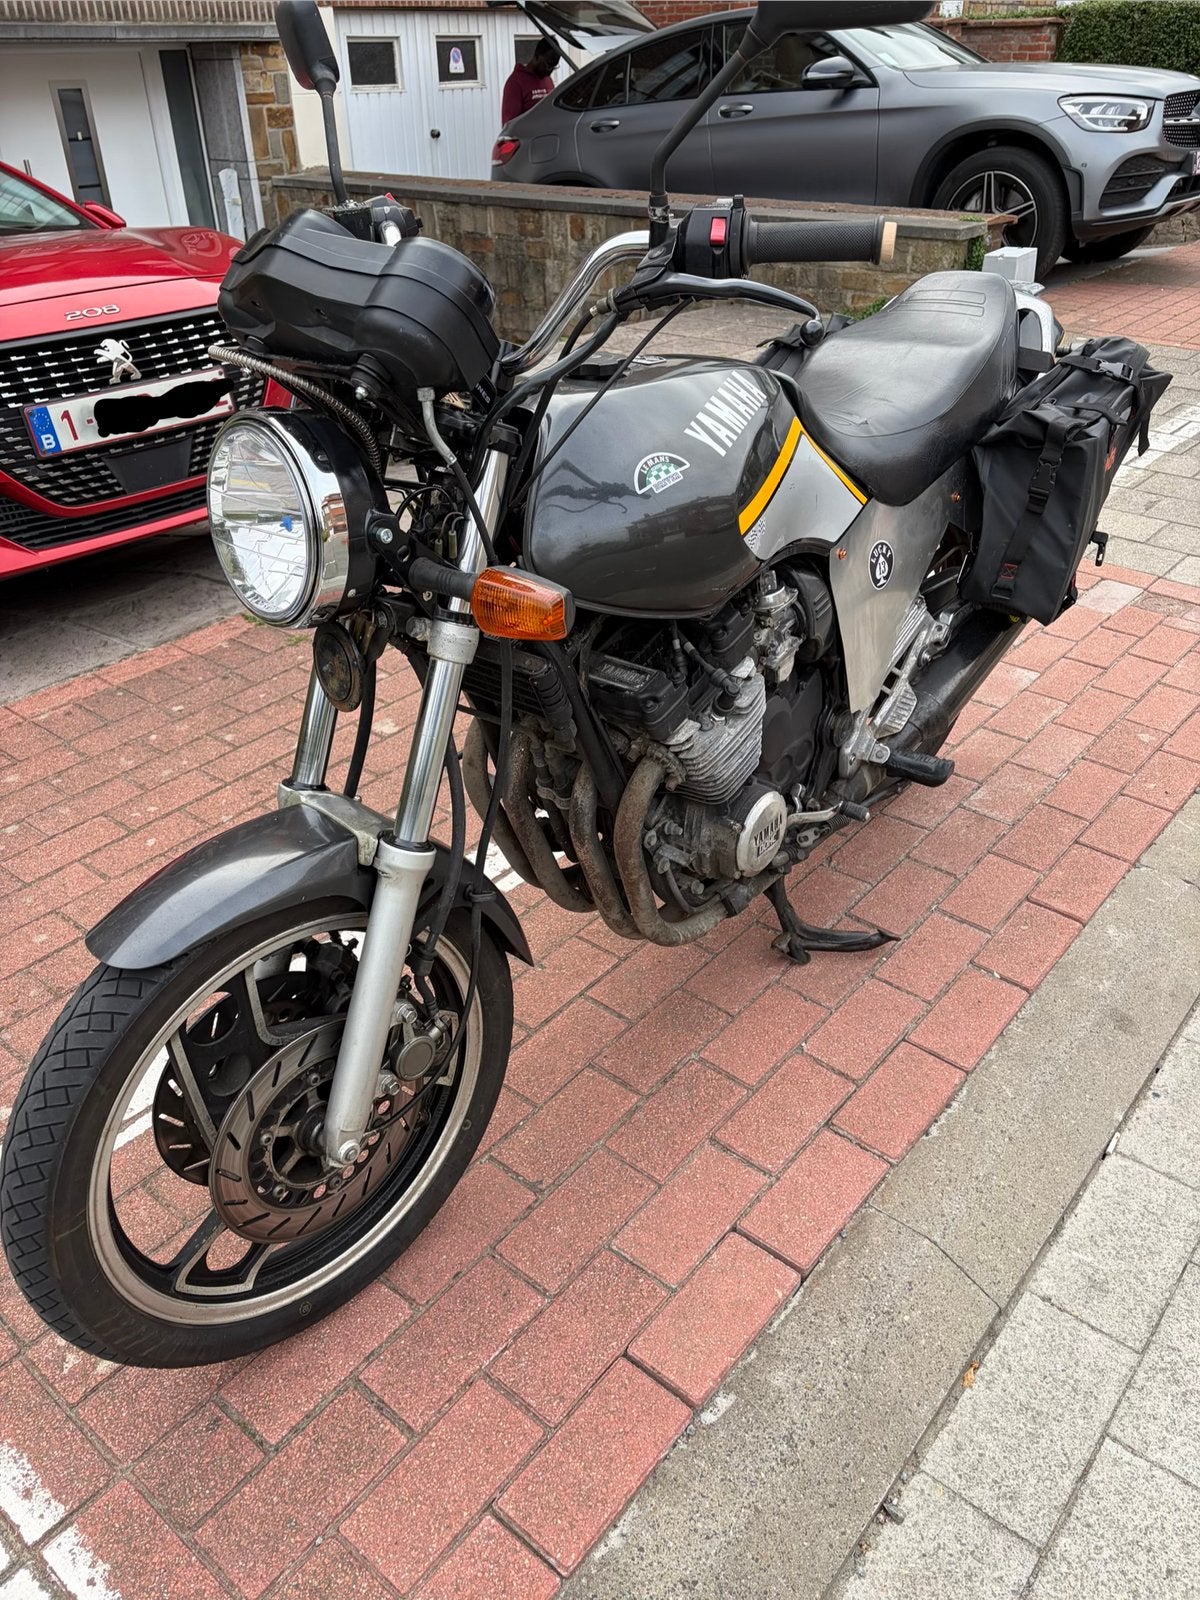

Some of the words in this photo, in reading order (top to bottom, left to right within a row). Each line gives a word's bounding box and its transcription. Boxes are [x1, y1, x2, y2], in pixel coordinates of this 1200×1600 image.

[65, 304, 121, 321] 208
[683, 370, 768, 457] YAMAHA
[41, 434, 56, 450] B
[870, 544, 892, 564] LUCKY
[878, 560, 887, 576] 13
[753, 813, 783, 846] YAMAHA
